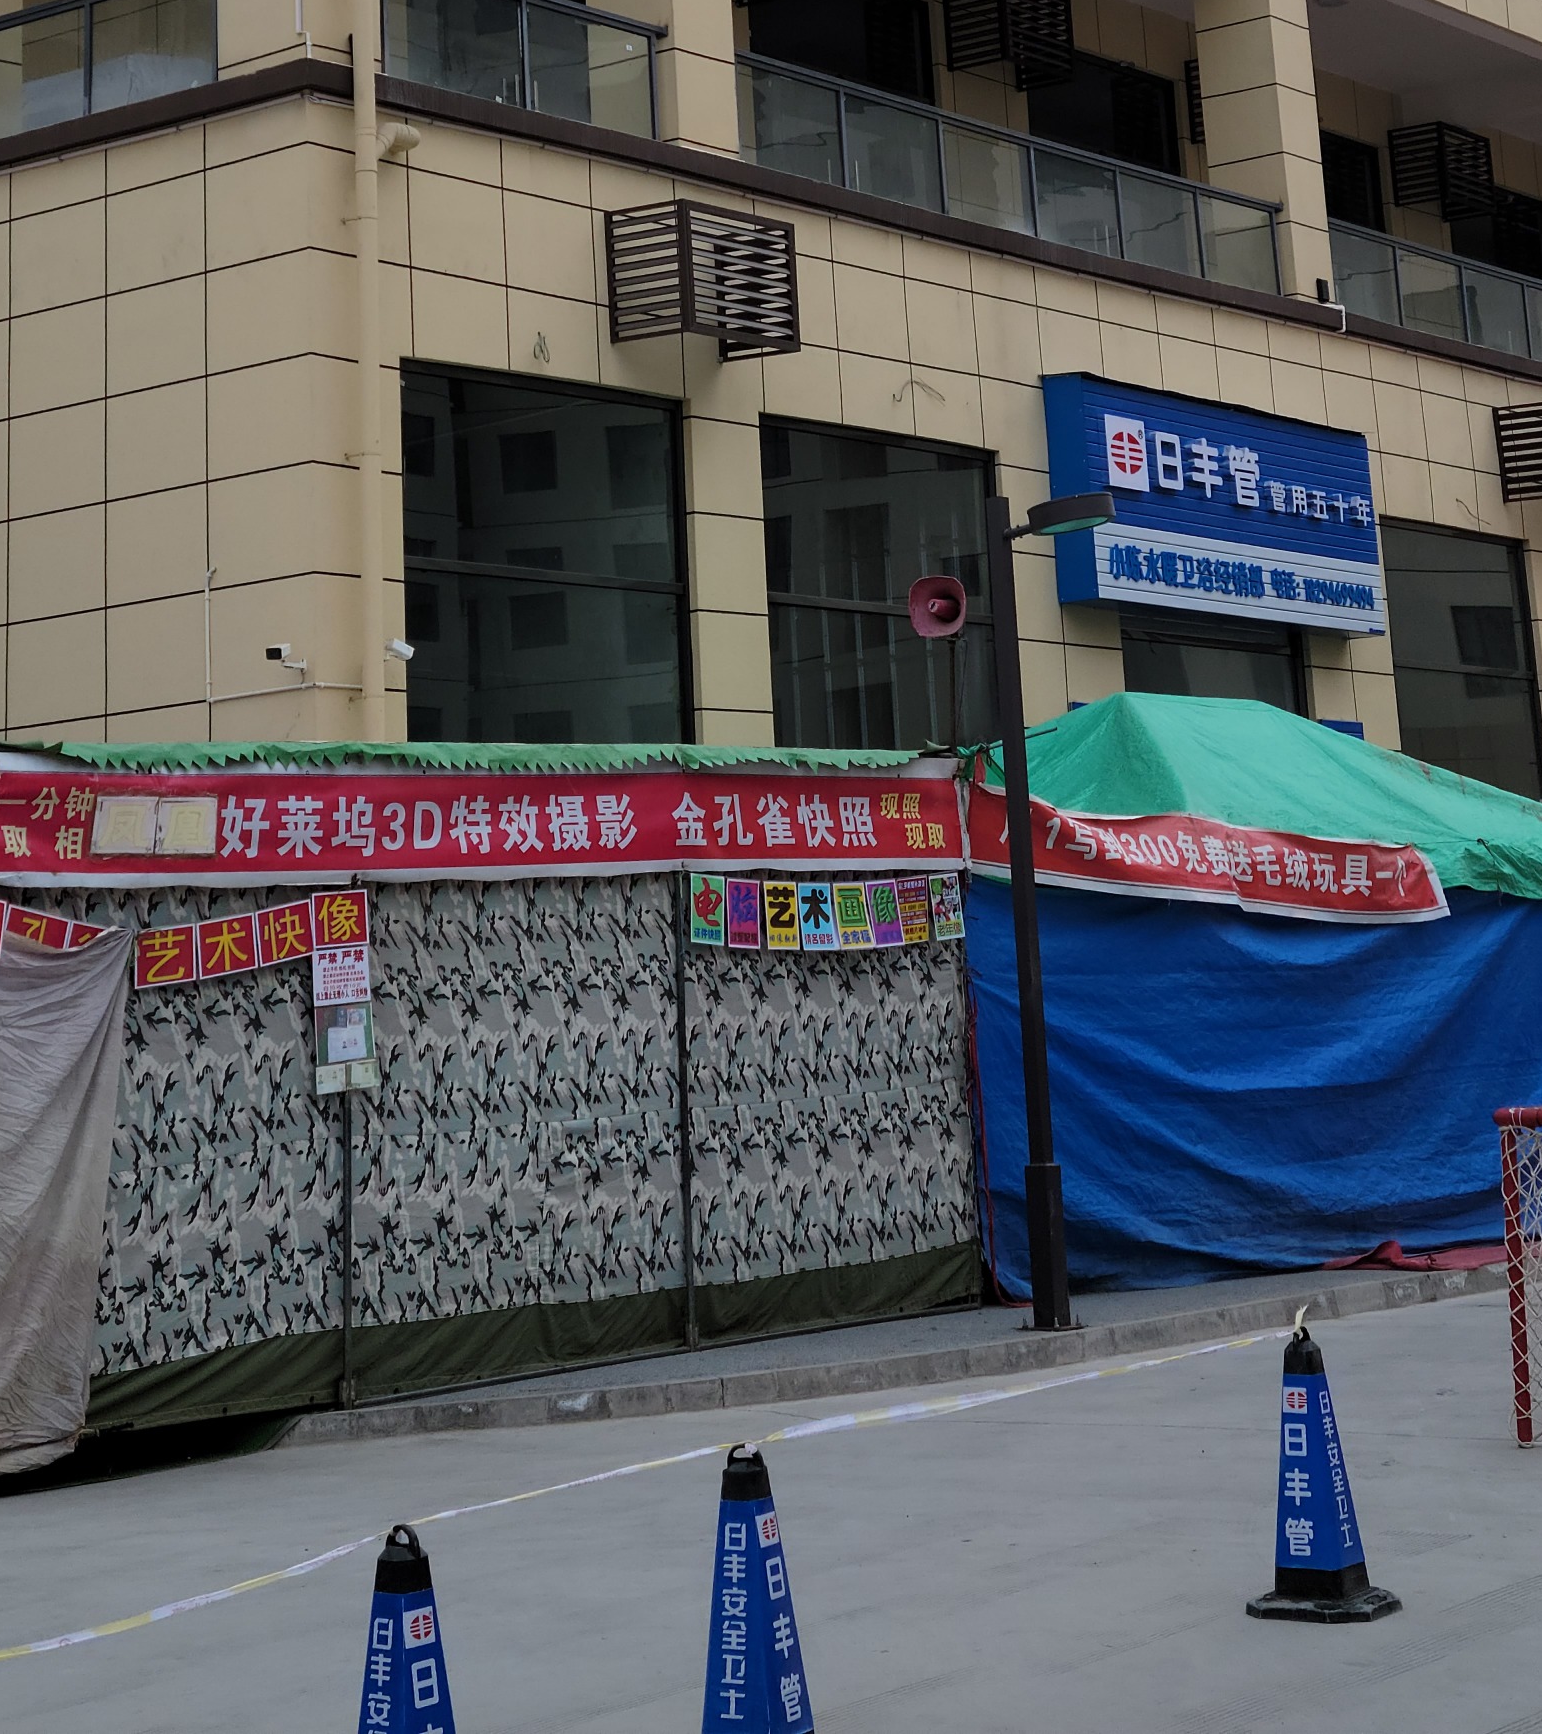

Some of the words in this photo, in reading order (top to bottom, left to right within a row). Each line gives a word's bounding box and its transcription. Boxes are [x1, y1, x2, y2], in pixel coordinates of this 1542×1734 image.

[1151, 430, 1260, 507] 日丰管
[1265, 480, 1373, 527] 管用五十年
[672, 790, 878, 848] 金孔雀快照
[879, 792, 922, 821] 现照
[905, 821, 948, 850] 现取
[1283, 1423, 1314, 1558] 日丰管
[1318, 1390, 1354, 1550] 日丰安全卫士
[719, 1522, 748, 1721] 日丰安全卫士
[765, 1556, 803, 1723] 日丰管
[366, 1617, 395, 1734] 日丰安
[411, 1657, 444, 1734] 日
